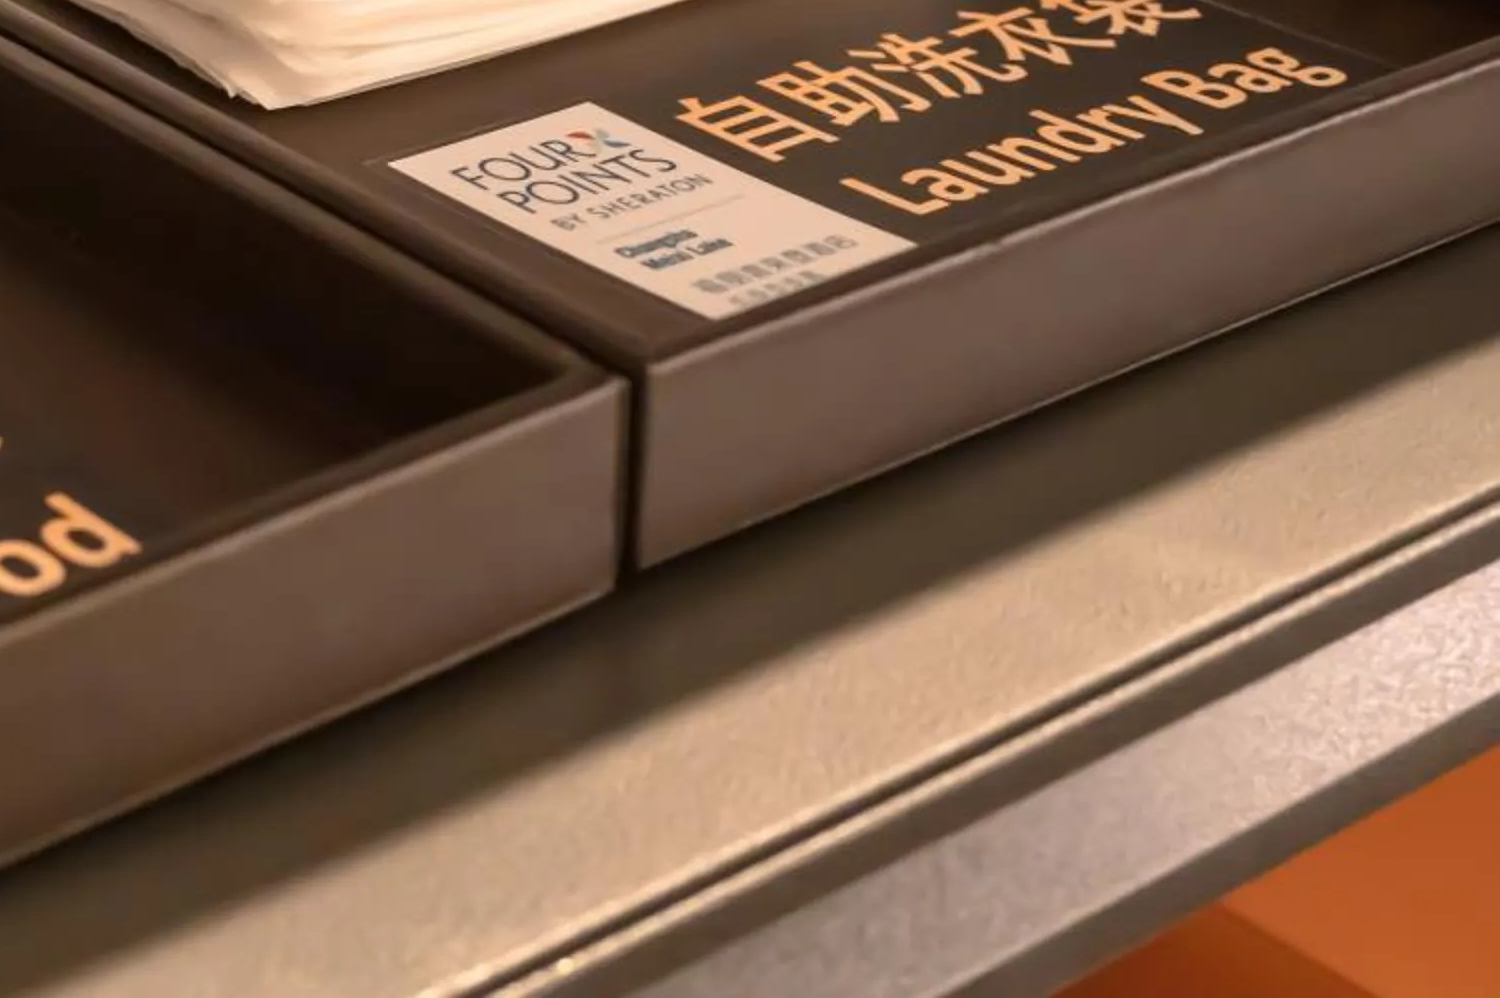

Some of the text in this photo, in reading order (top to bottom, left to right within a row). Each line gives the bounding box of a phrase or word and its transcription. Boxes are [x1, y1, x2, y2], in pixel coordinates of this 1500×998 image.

[842, 47, 1348, 216] Laundry Bag
[450, 139, 597, 191] FOUR
[497, 149, 678, 214] POINTS
[550, 173, 713, 232] BY SHERATON
